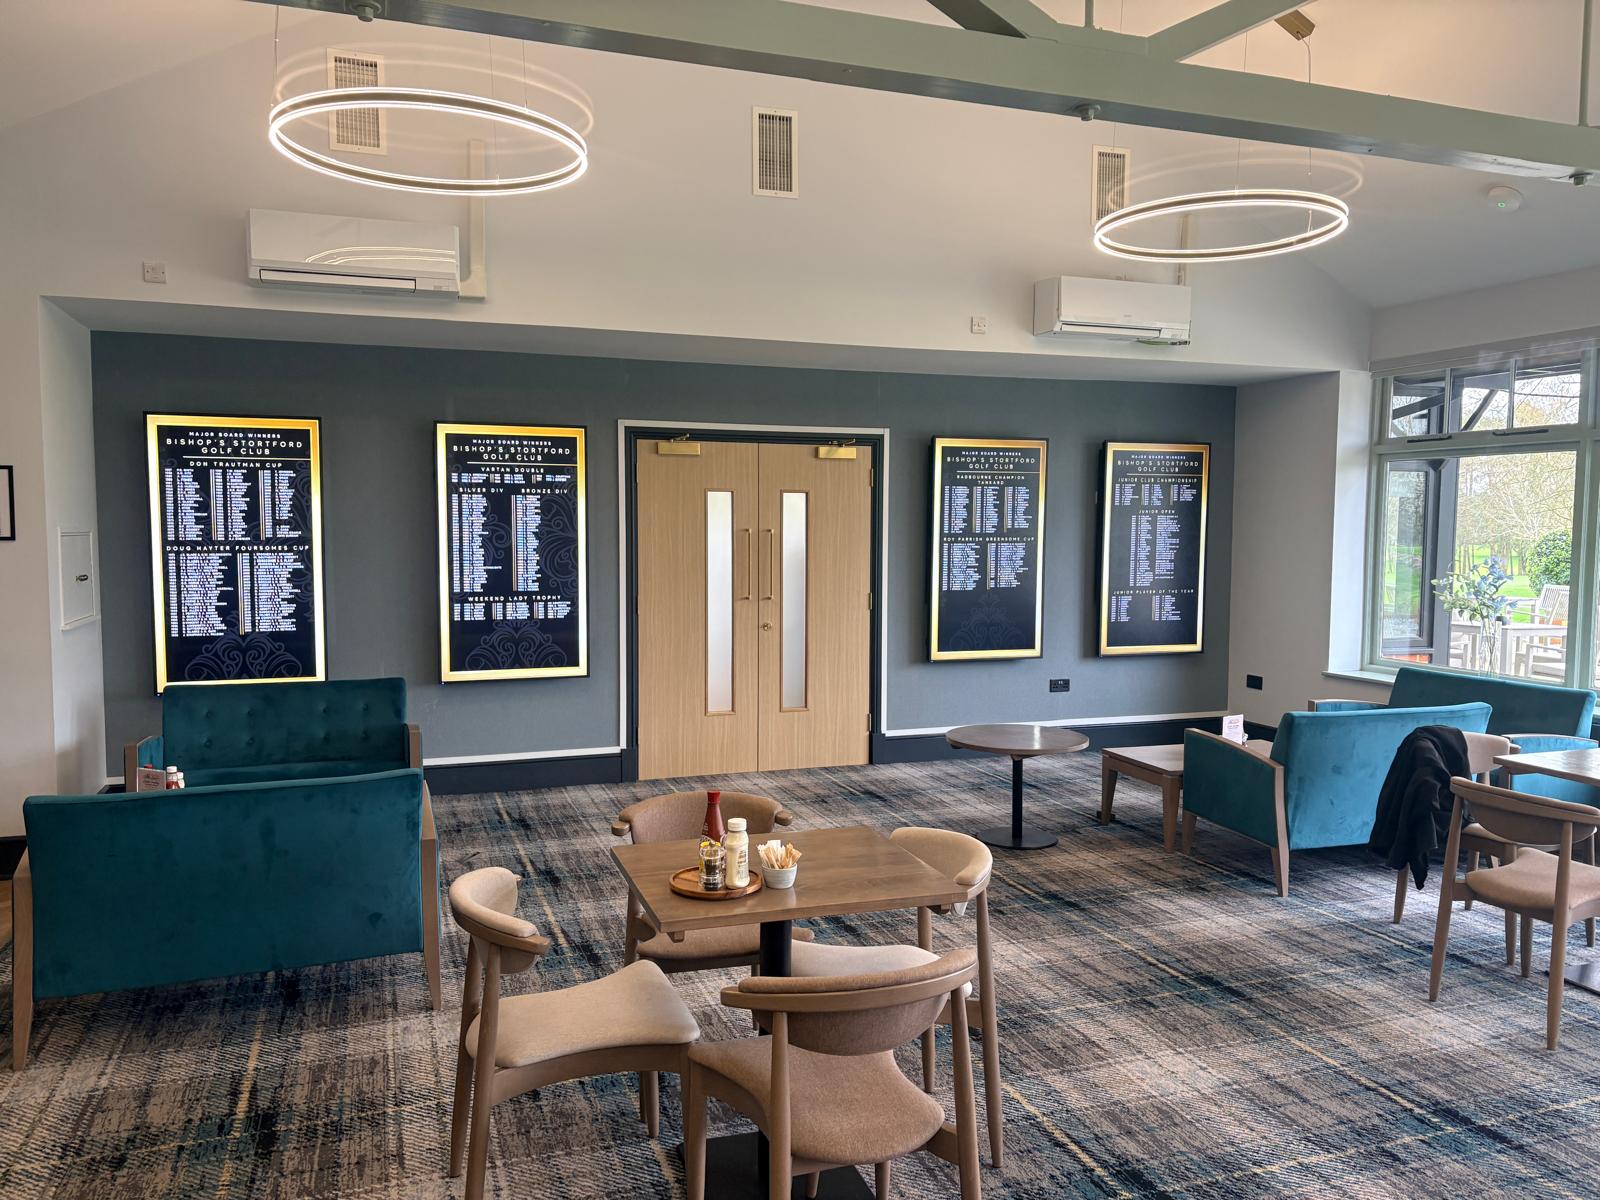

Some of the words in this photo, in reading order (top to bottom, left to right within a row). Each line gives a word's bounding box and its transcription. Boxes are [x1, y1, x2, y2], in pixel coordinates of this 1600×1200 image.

[166, 438, 225, 446] BISHOP'S
[233, 439, 303, 448] STORTFORD
[453, 445, 503, 453] BISHOP'S
[510, 446, 570, 454] STORTFORD
